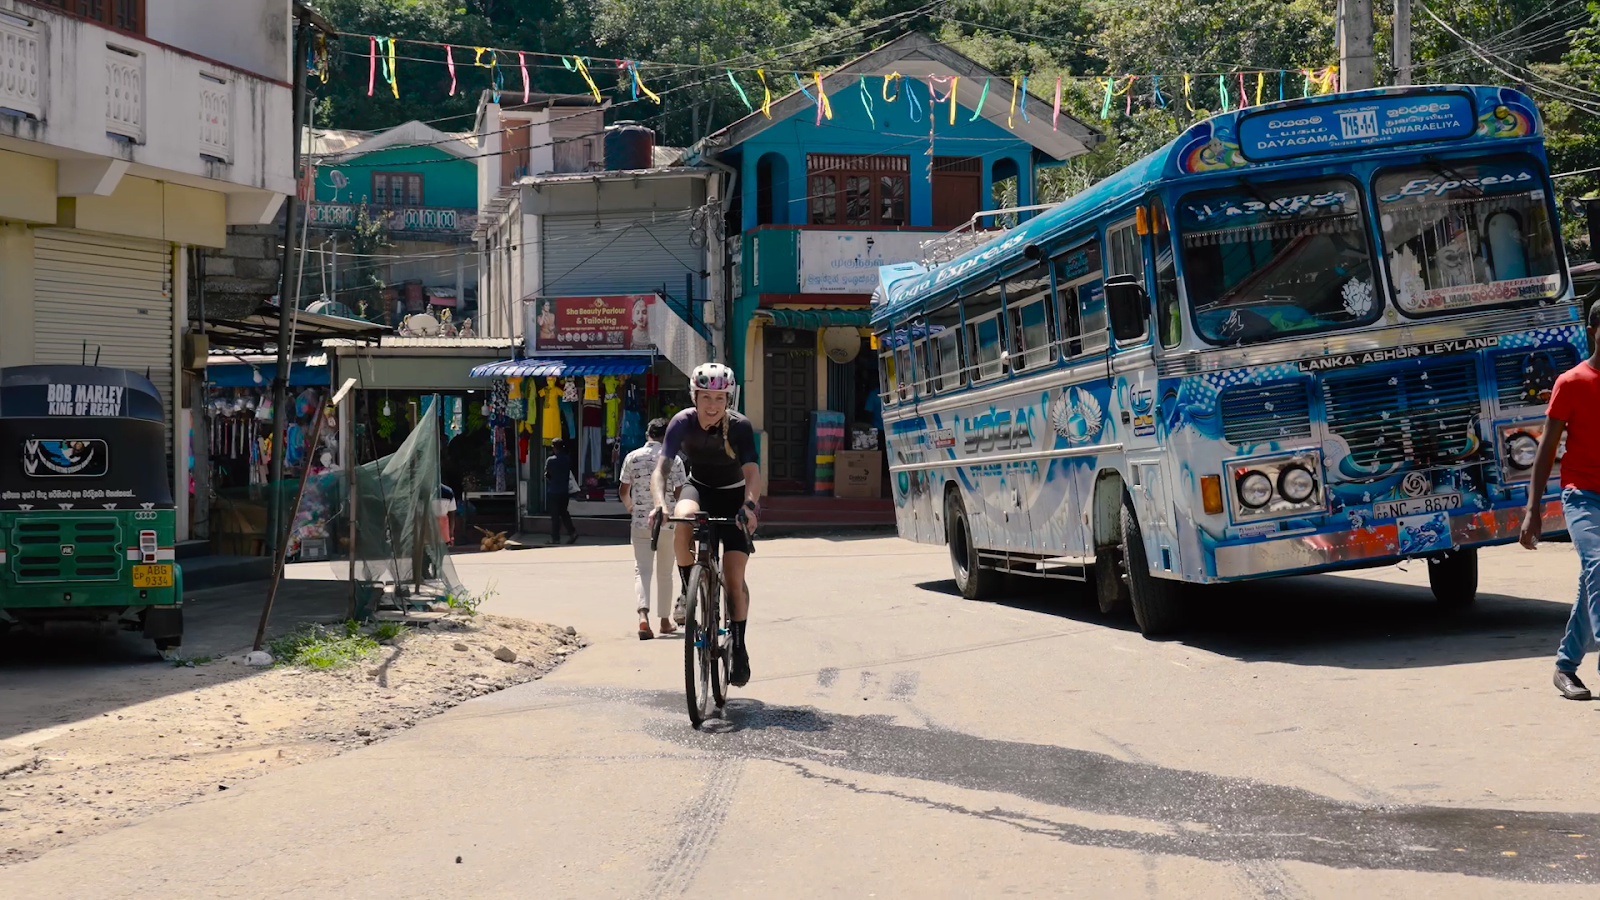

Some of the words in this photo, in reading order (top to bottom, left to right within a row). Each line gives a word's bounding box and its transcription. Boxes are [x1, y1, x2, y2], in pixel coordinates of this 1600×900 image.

[1381, 120, 1460, 135] NUWARAELIYA
[1257, 134, 1339, 150] DAYAGAMA
[1380, 172, 1532, 202] Express
[934, 230, 1027, 284] Express
[579, 308, 601, 316] Beauty
[602, 307, 625, 315] Parlour
[583, 317, 617, 325] Tailoring
[1299, 355, 1355, 372] LANKA
[1362, 346, 1420, 364] ASHOK
[1425, 336, 1499, 355] LEYLAND
[47, 383, 72, 402] BOB
[75, 384, 124, 404] MARLEY
[48, 402, 73, 415] KING
[75, 402, 88, 416] OF
[90, 403, 121, 416] REGAY
[1389, 502, 1408, 518] NC
[1424, 495, 1460, 513] 8879
[134, 572, 144, 580] CP
[147, 565, 167, 575] ABG
[145, 576, 168, 586] 9334
